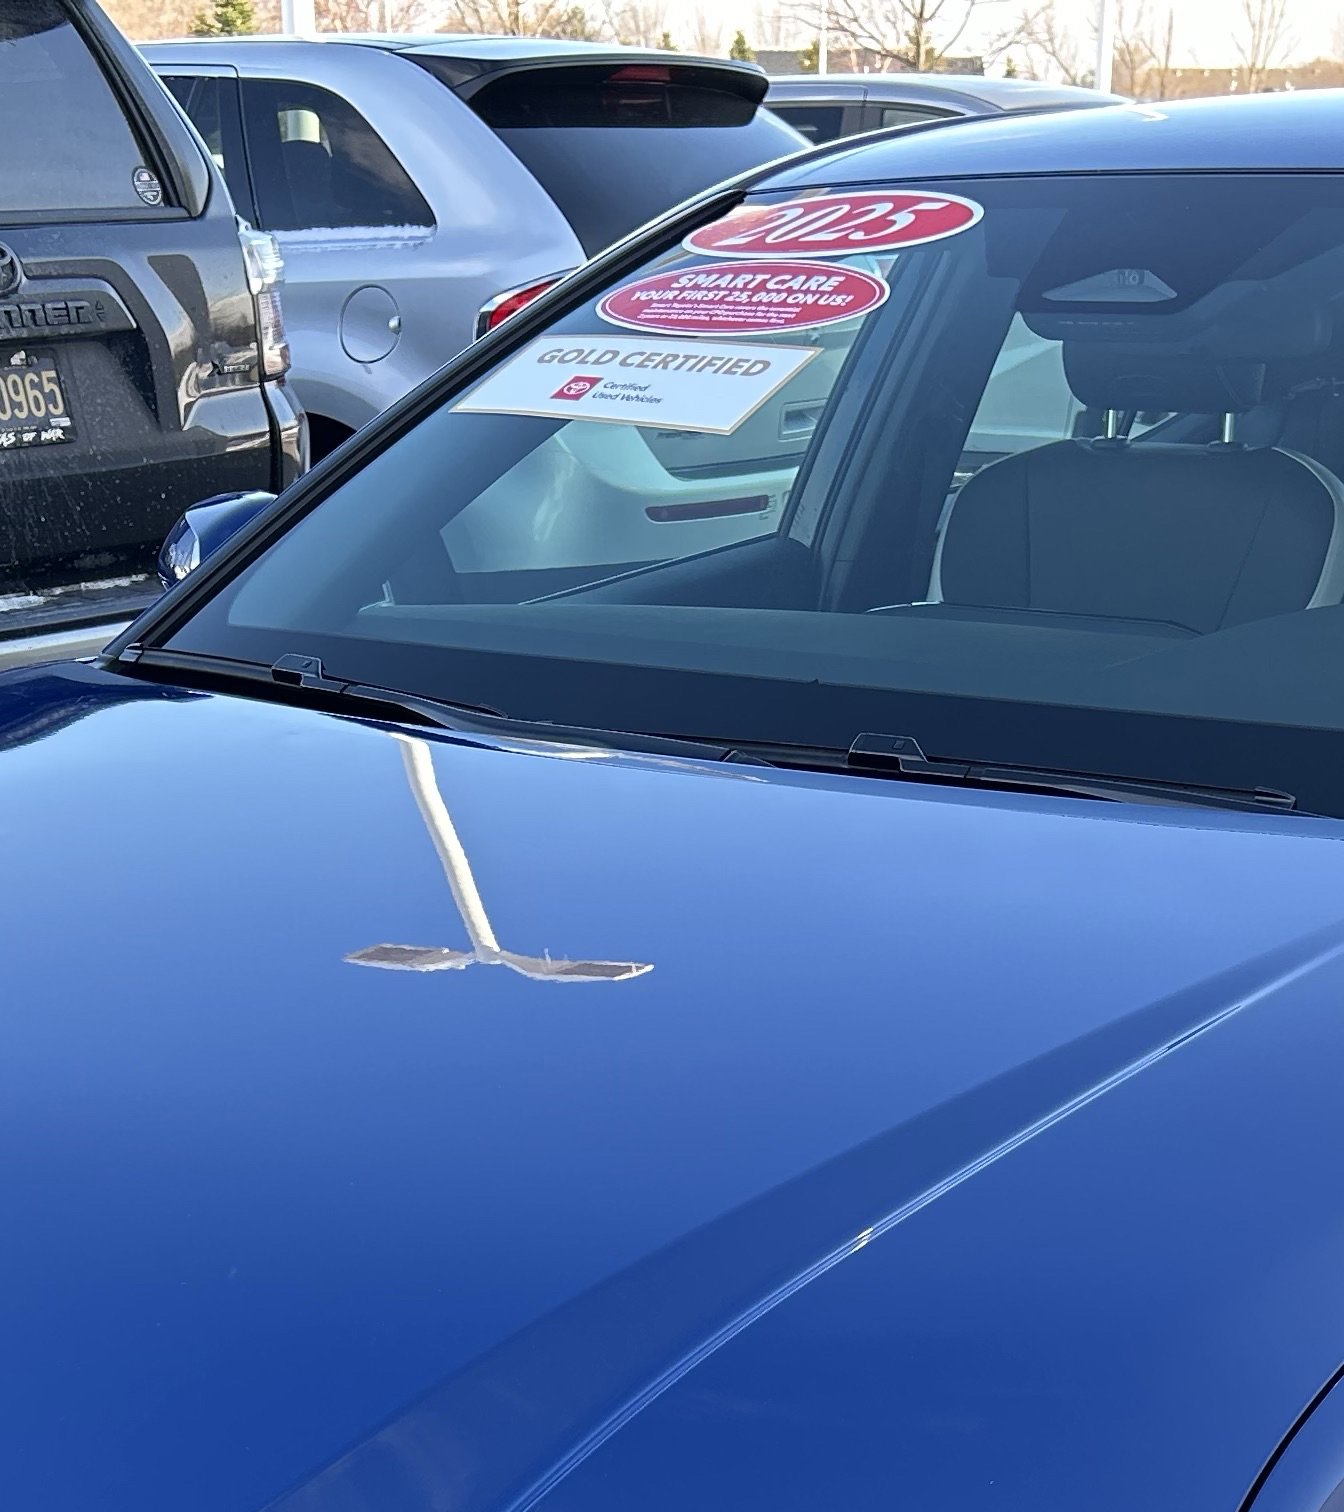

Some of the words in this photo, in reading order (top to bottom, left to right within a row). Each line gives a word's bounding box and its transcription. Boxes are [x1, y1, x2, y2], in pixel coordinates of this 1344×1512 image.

[712, 201, 949, 248] 2025
[671, 273, 771, 290] SMART
[766, 274, 846, 292] CARE
[630, 289, 679, 301] YOUR
[677, 290, 730, 301] FIRST
[786, 293, 819, 303] ON
[817, 294, 855, 307] US!
[536, 348, 620, 366] GOLD
[618, 351, 771, 377] CERTIFIED
[603, 381, 650, 392] Certified
[592, 392, 619, 401] Used
[621, 394, 662, 404] Vehicles
